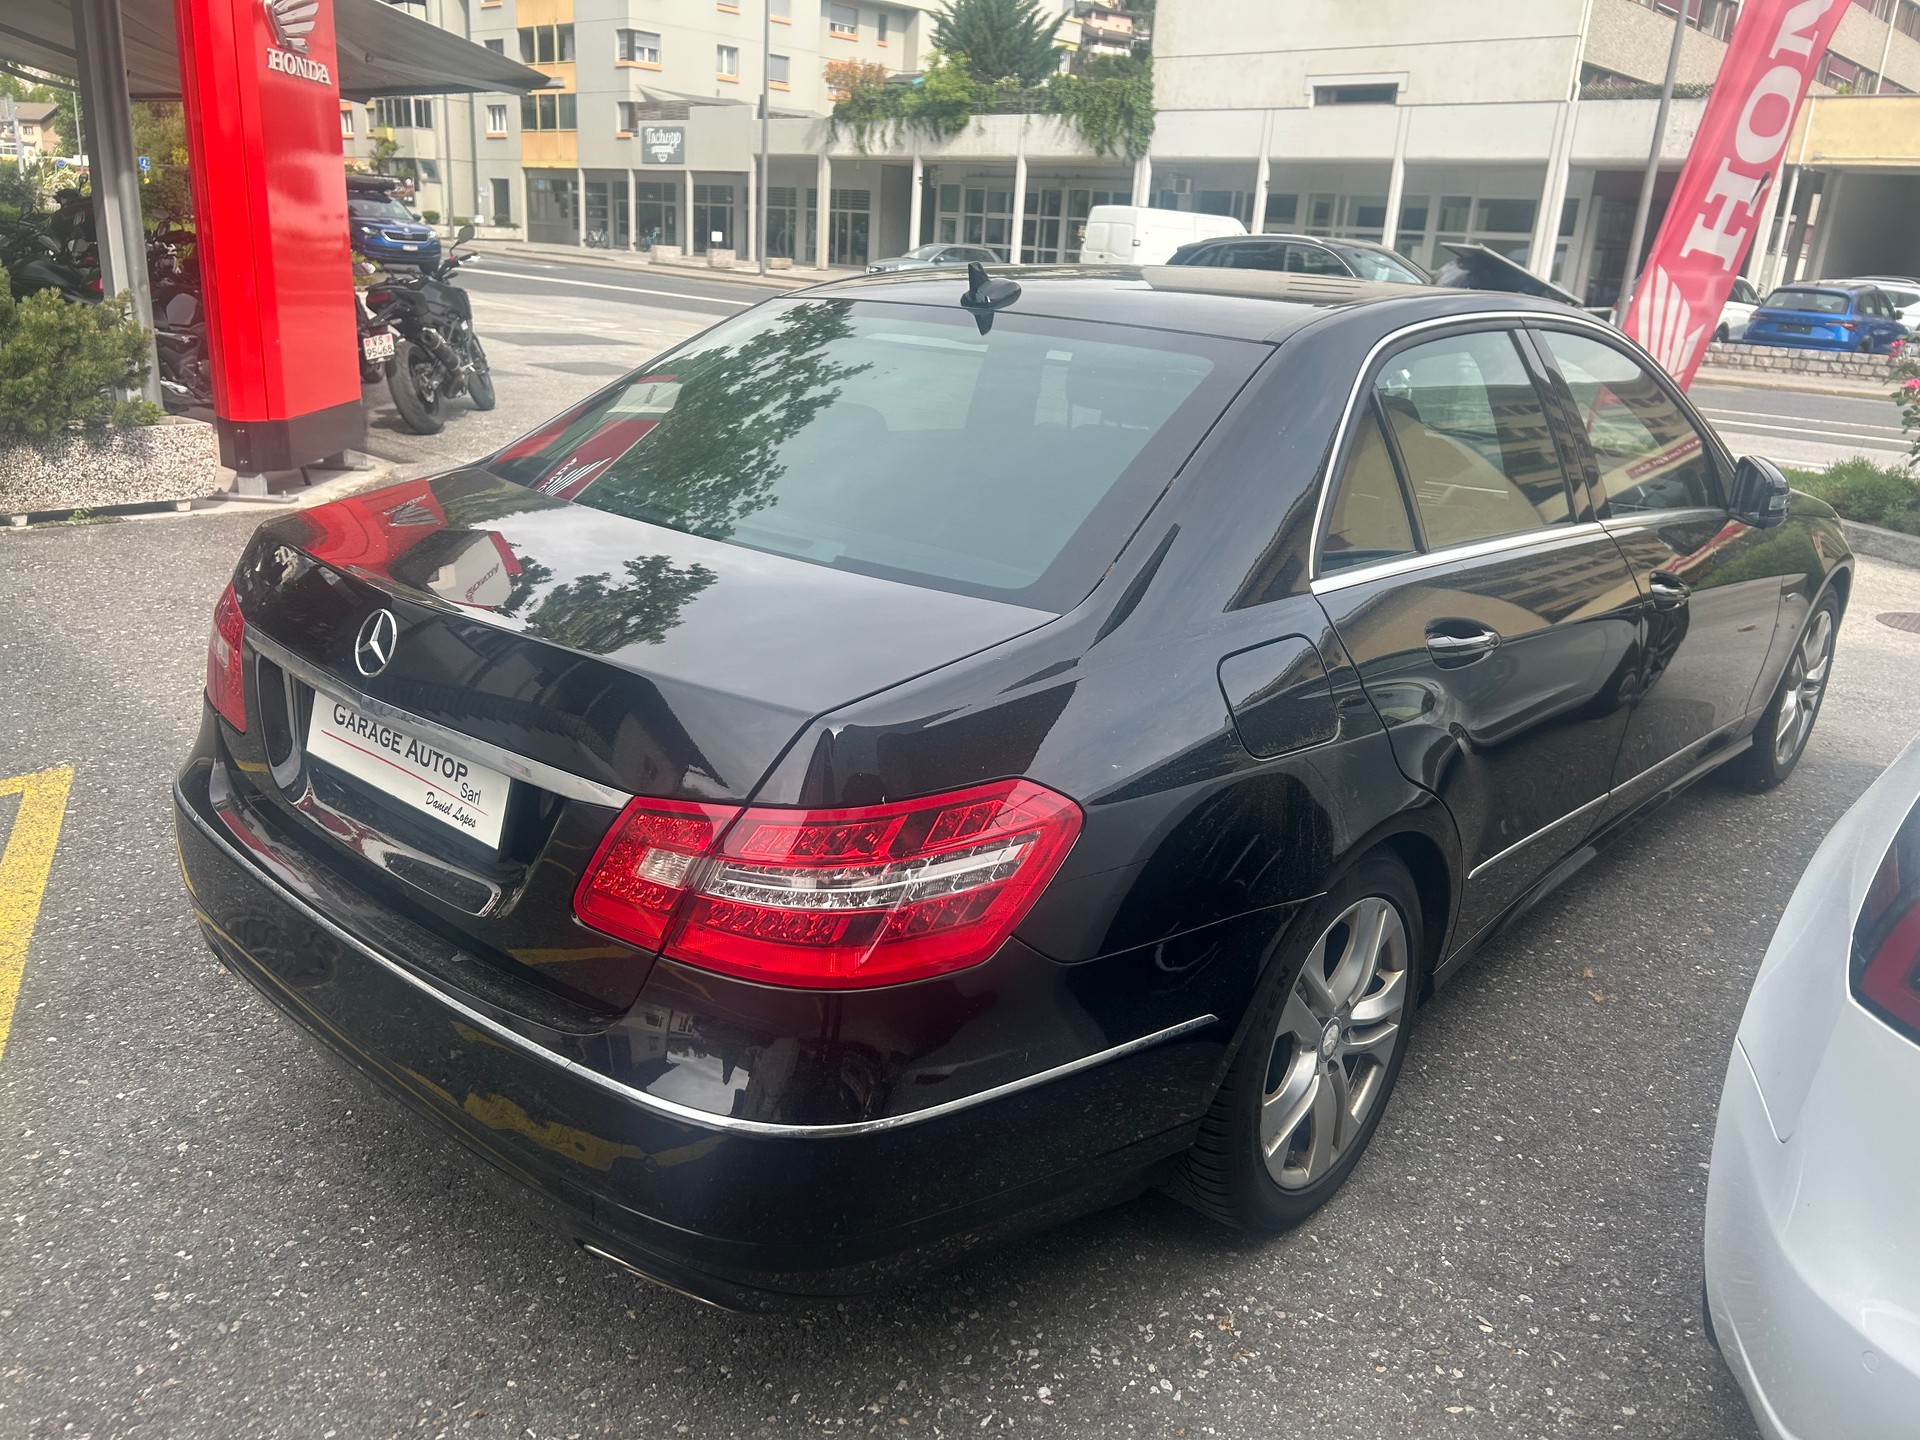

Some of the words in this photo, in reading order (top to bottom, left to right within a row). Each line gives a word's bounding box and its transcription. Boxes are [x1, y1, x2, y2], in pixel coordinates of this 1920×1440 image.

[267, 48, 332, 85] HONDA
[373, 336, 384, 347] VS
[333, 704, 403, 755] GARAGE
[405, 739, 468, 783] AUTOP
[426, 791, 453, 816] Daniel
[452, 807, 477, 829] Lopes
[460, 783, 481, 806] Sarl
